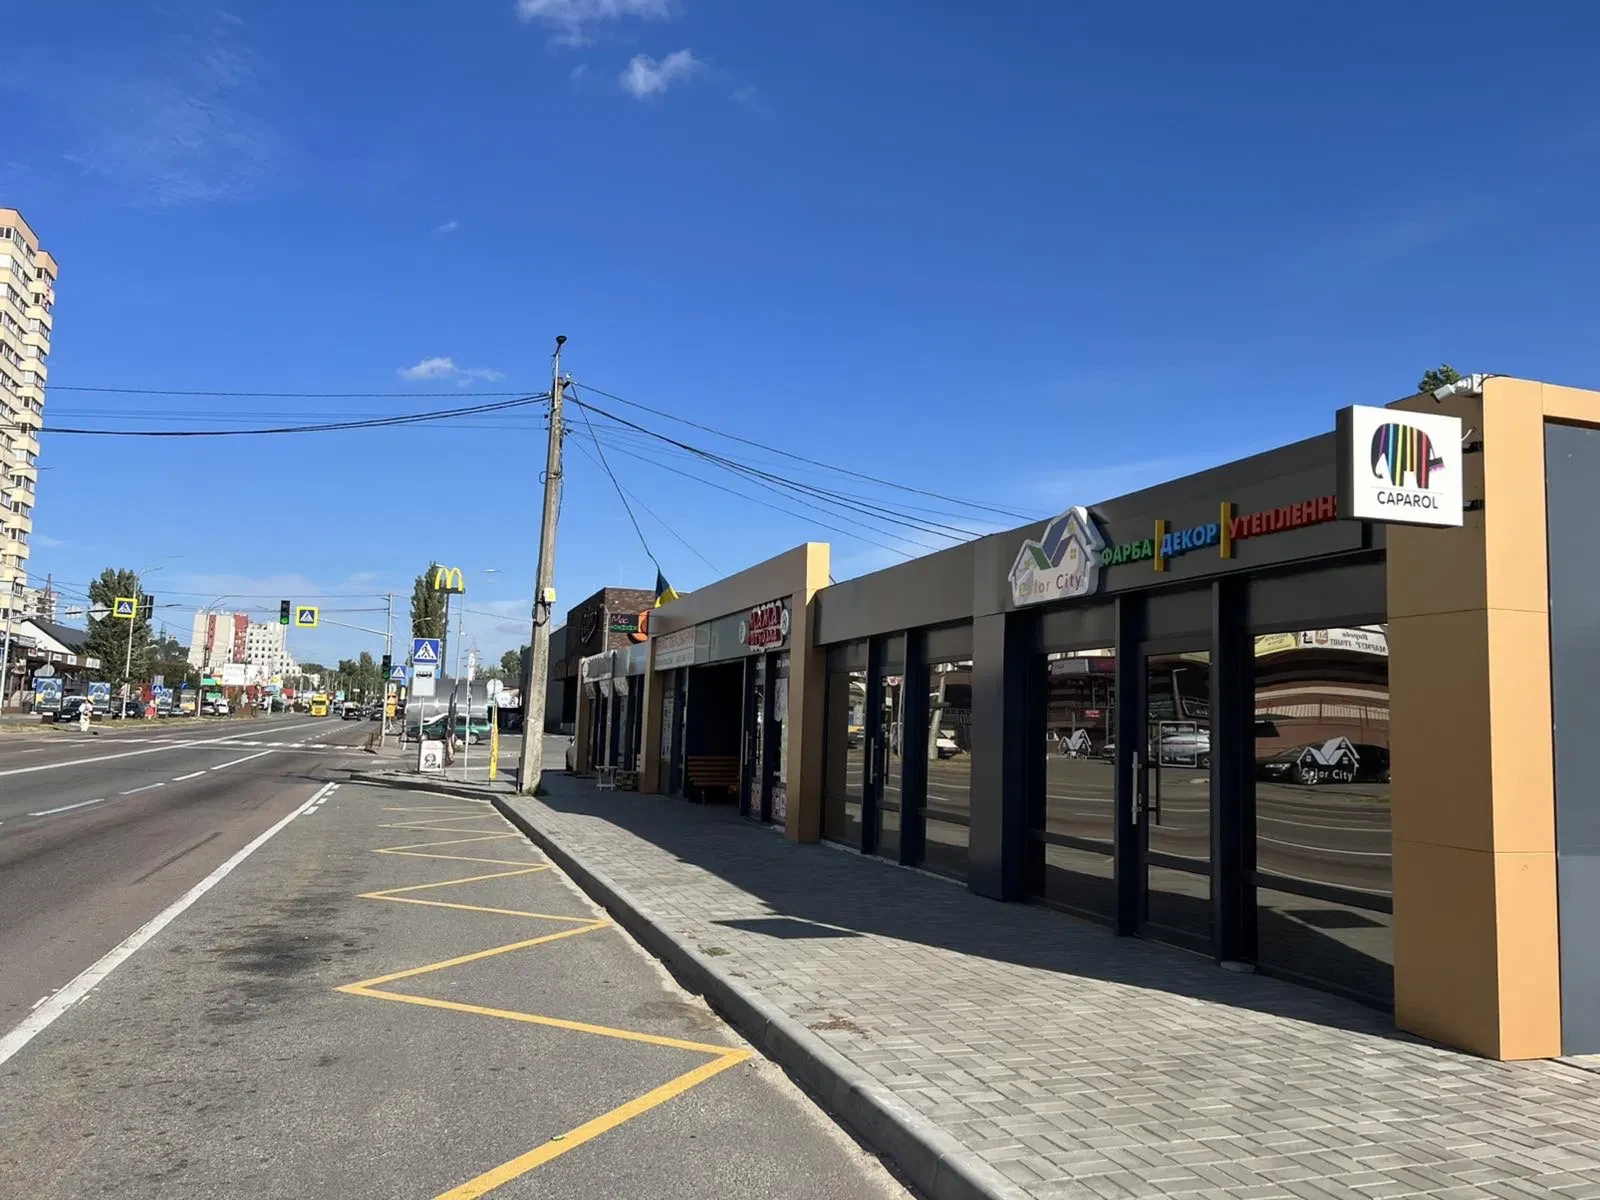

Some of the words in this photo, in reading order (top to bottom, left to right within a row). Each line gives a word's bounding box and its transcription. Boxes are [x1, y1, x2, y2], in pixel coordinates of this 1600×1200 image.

[1377, 491, 1438, 509] CAPAROL
[1101, 539, 1152, 566] ФАРБА
[1162, 523, 1218, 555] ДЕКОР
[1229, 495, 1337, 539] УТЕПЛЕНН
[1056, 572, 1082, 591] City
[1332, 769, 1353, 782] City
